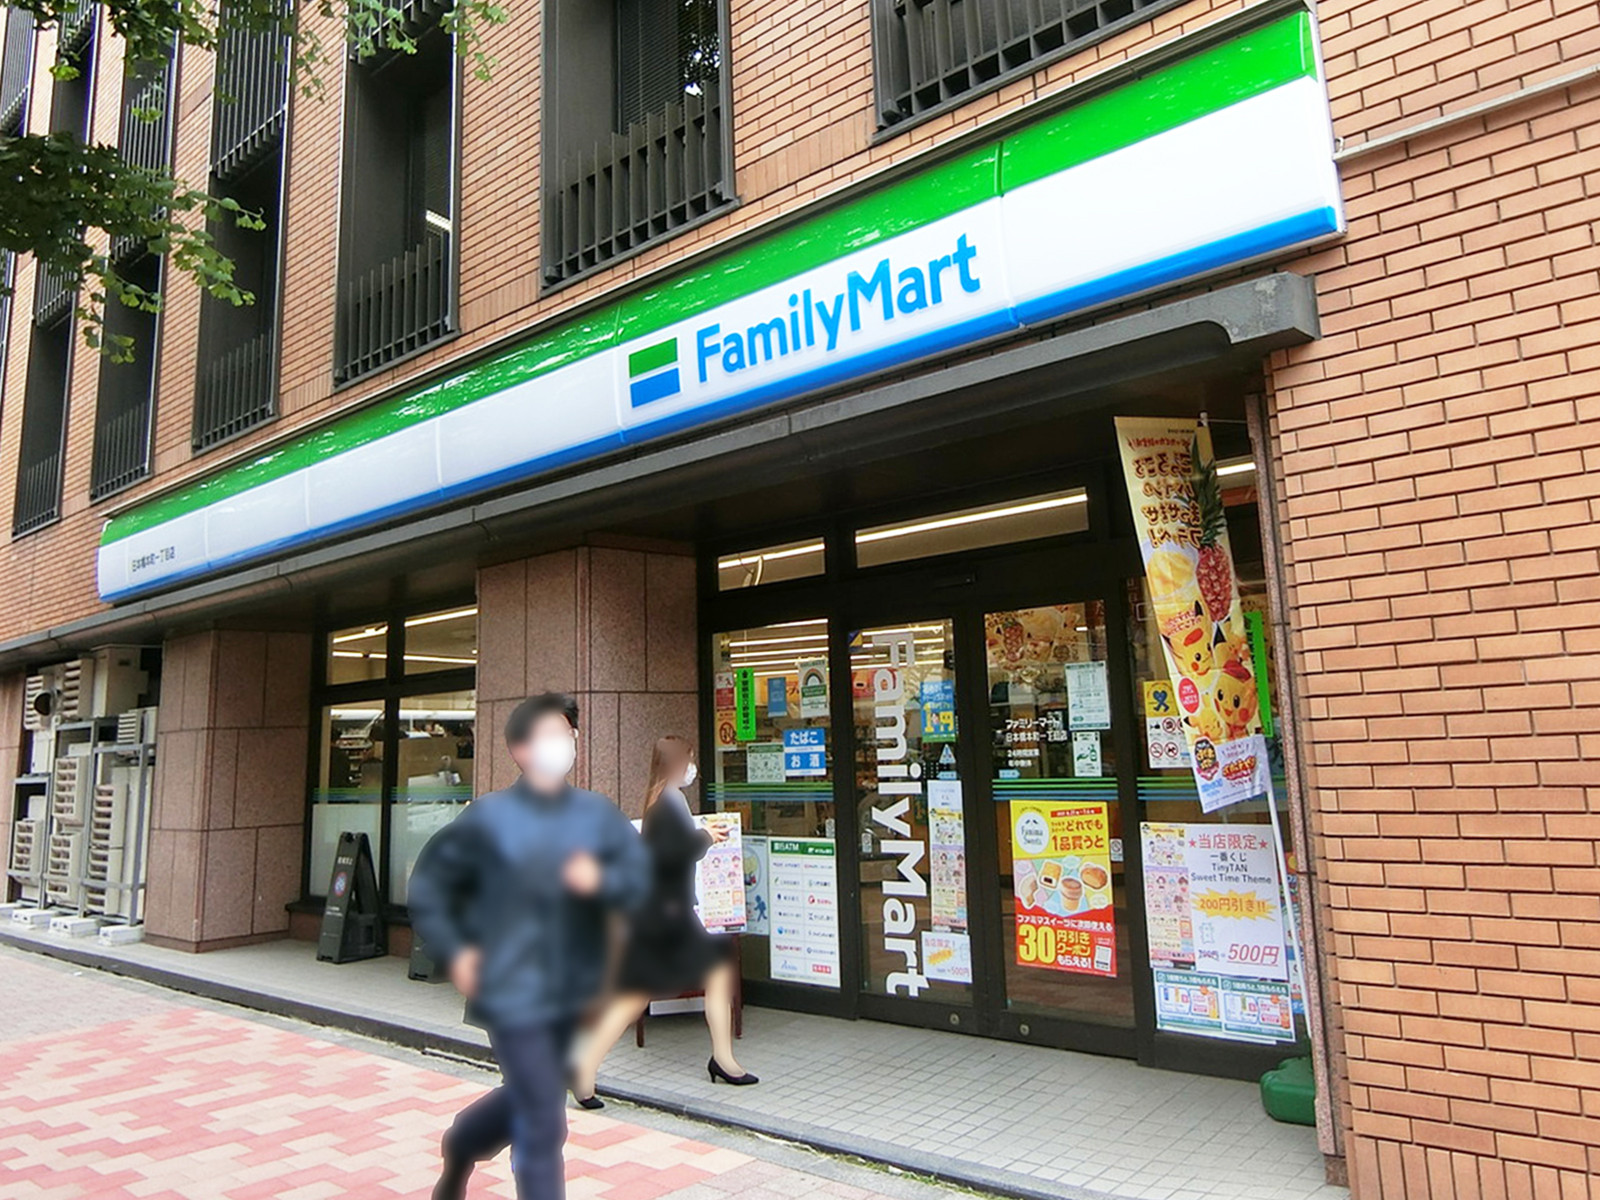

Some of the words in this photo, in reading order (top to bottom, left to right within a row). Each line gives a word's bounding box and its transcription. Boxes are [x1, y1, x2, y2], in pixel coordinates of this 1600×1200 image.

[696, 232, 983, 383] FamilyMart
[790, 731, 819, 744] たばこ
[790, 754, 820, 768] お酒
[871, 631, 929, 997] FamilyMart
[1066, 819, 1104, 832] どれでも
[1052, 835, 1105, 852] 1品買うと
[1199, 834, 1257, 850] 当店限定
[1210, 851, 1247, 862] 一番くじ
[1211, 862, 1248, 873] TinyTAN
[1190, 873, 1217, 883] Sweet
[1218, 874, 1240, 884] Time
[1242, 875, 1271, 886] Theme
[1018, 923, 1056, 964] 30
[1057, 929, 1091, 945] 円引き
[1228, 943, 1279, 966] 500円
